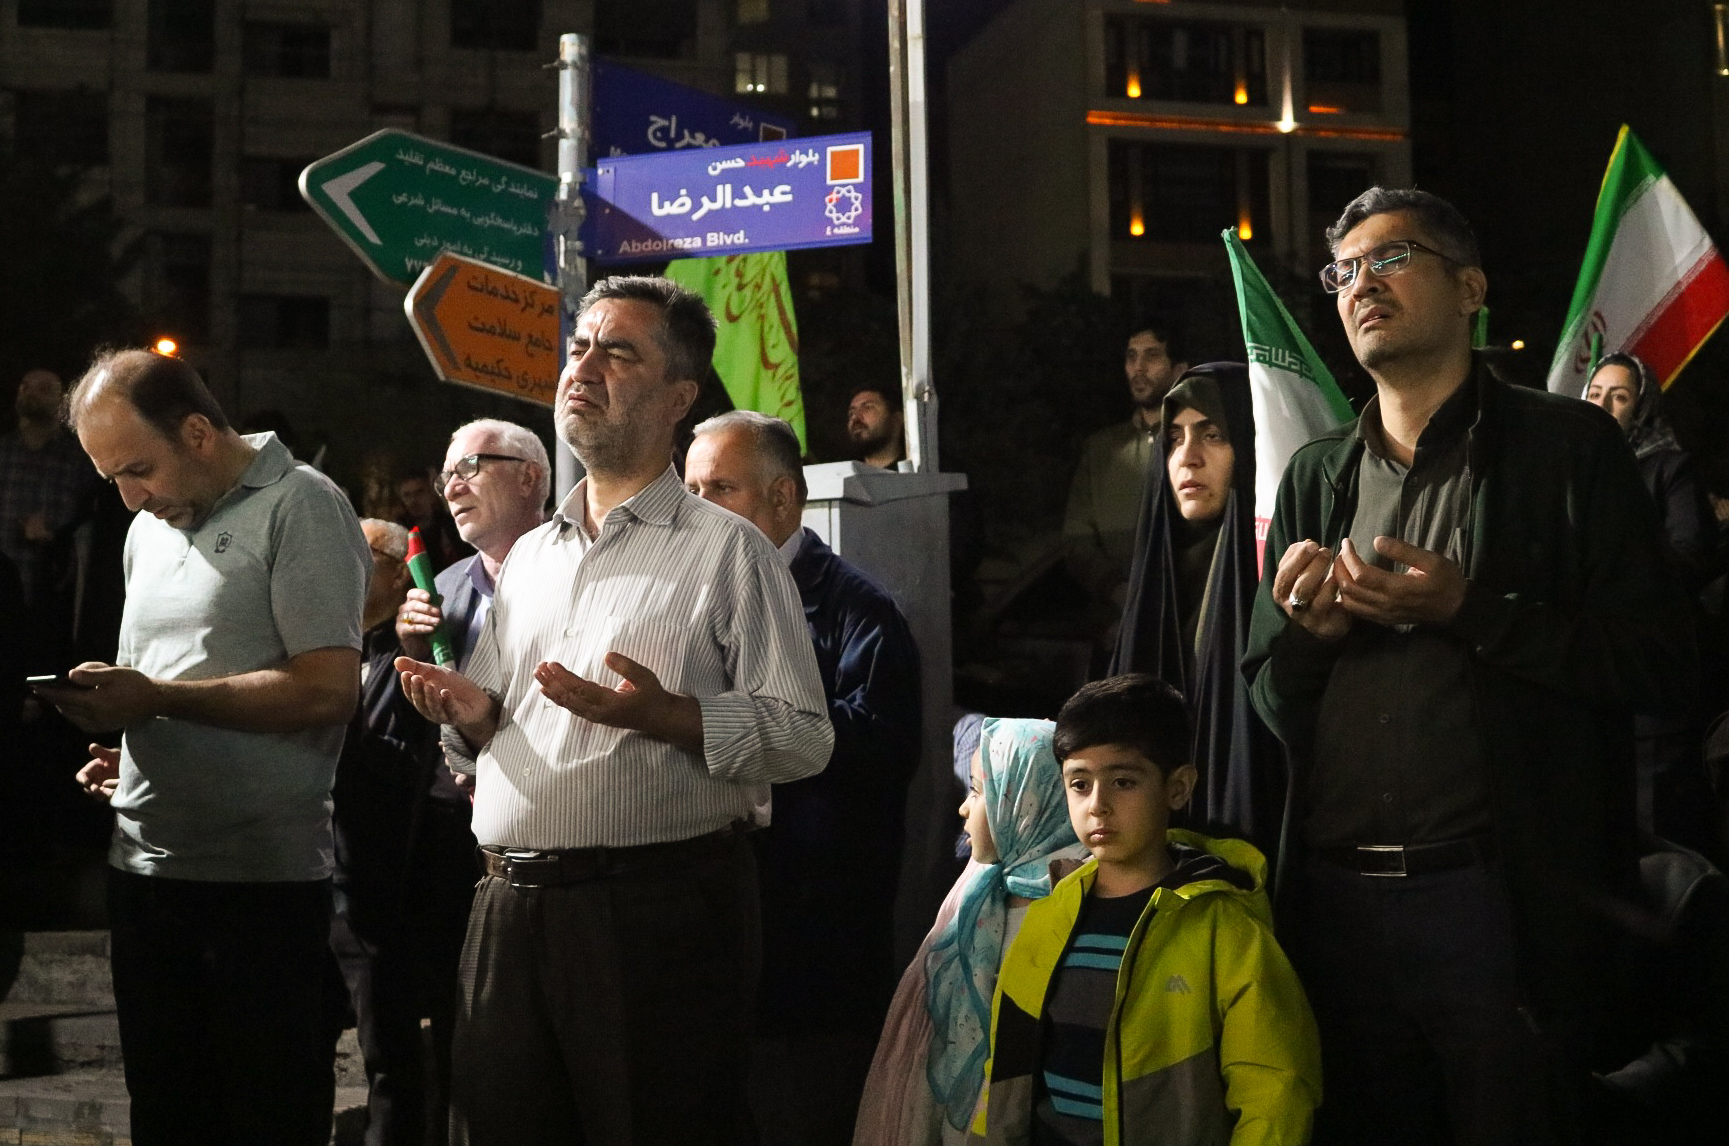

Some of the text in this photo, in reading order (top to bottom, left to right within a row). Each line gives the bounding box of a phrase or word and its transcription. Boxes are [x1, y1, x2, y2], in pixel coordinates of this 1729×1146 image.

[647, 114, 720, 149] معراج
[396, 150, 425, 167] تقلید
[426, 157, 457, 175] معظم
[708, 149, 820, 176] بلوار شهید حسن
[459, 168, 490, 186] مراجع
[392, 192, 425, 206] شرعی
[651, 183, 793, 221] عبدالرضا
[460, 207, 471, 222] به
[706, 229, 750, 247] Blvd.
[467, 275, 555, 318] مرکز خدمات
[466, 316, 554, 358] جامع سلامت
